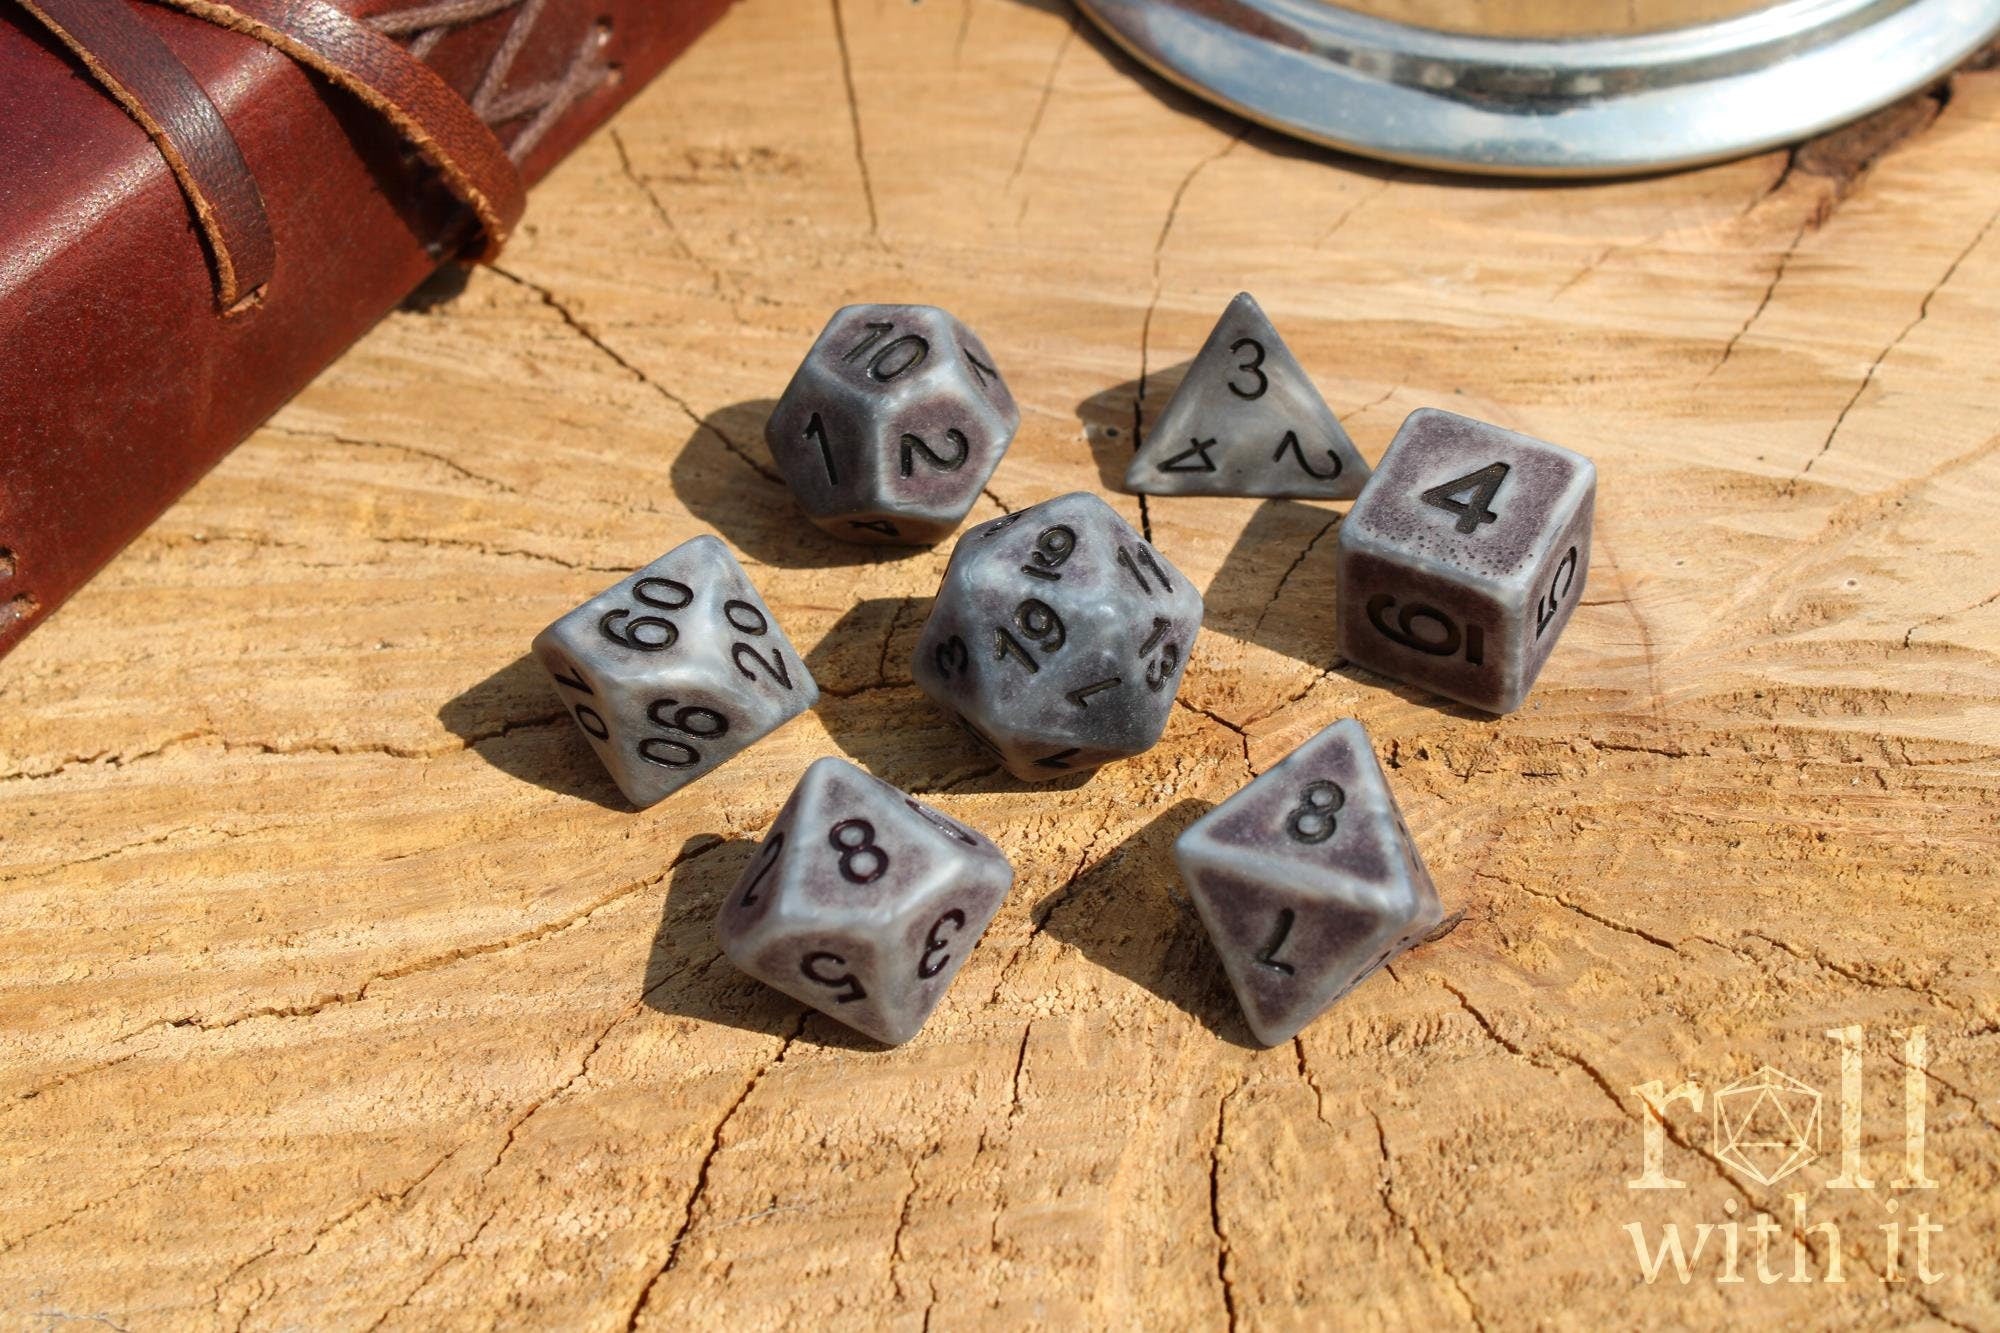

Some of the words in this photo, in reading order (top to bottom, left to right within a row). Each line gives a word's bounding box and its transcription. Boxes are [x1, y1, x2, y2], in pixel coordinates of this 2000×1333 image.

[840, 322, 930, 383] 10
[1228, 338, 1268, 401] 3
[802, 412, 838, 486] 1
[900, 428, 970, 479] 2
[1157, 438, 1218, 474] 4
[1272, 430, 1344, 481] 2
[1421, 461, 1511, 534] 4
[1117, 541, 1173, 595] 11
[1536, 546, 1578, 641] 5
[599, 577, 694, 653] 60
[723, 599, 793, 691] 20
[992, 598, 1067, 674] 19
[1366, 593, 1485, 667] 6
[935, 635, 969, 680] 3
[637, 698, 730, 769] 90
[1286, 779, 1346, 845] 8
[740, 832, 785, 908] 2
[828, 818, 890, 884] 8
[917, 908, 967, 981] 3
[1253, 907, 1296, 977] 7
[799, 951, 868, 1005] 5
